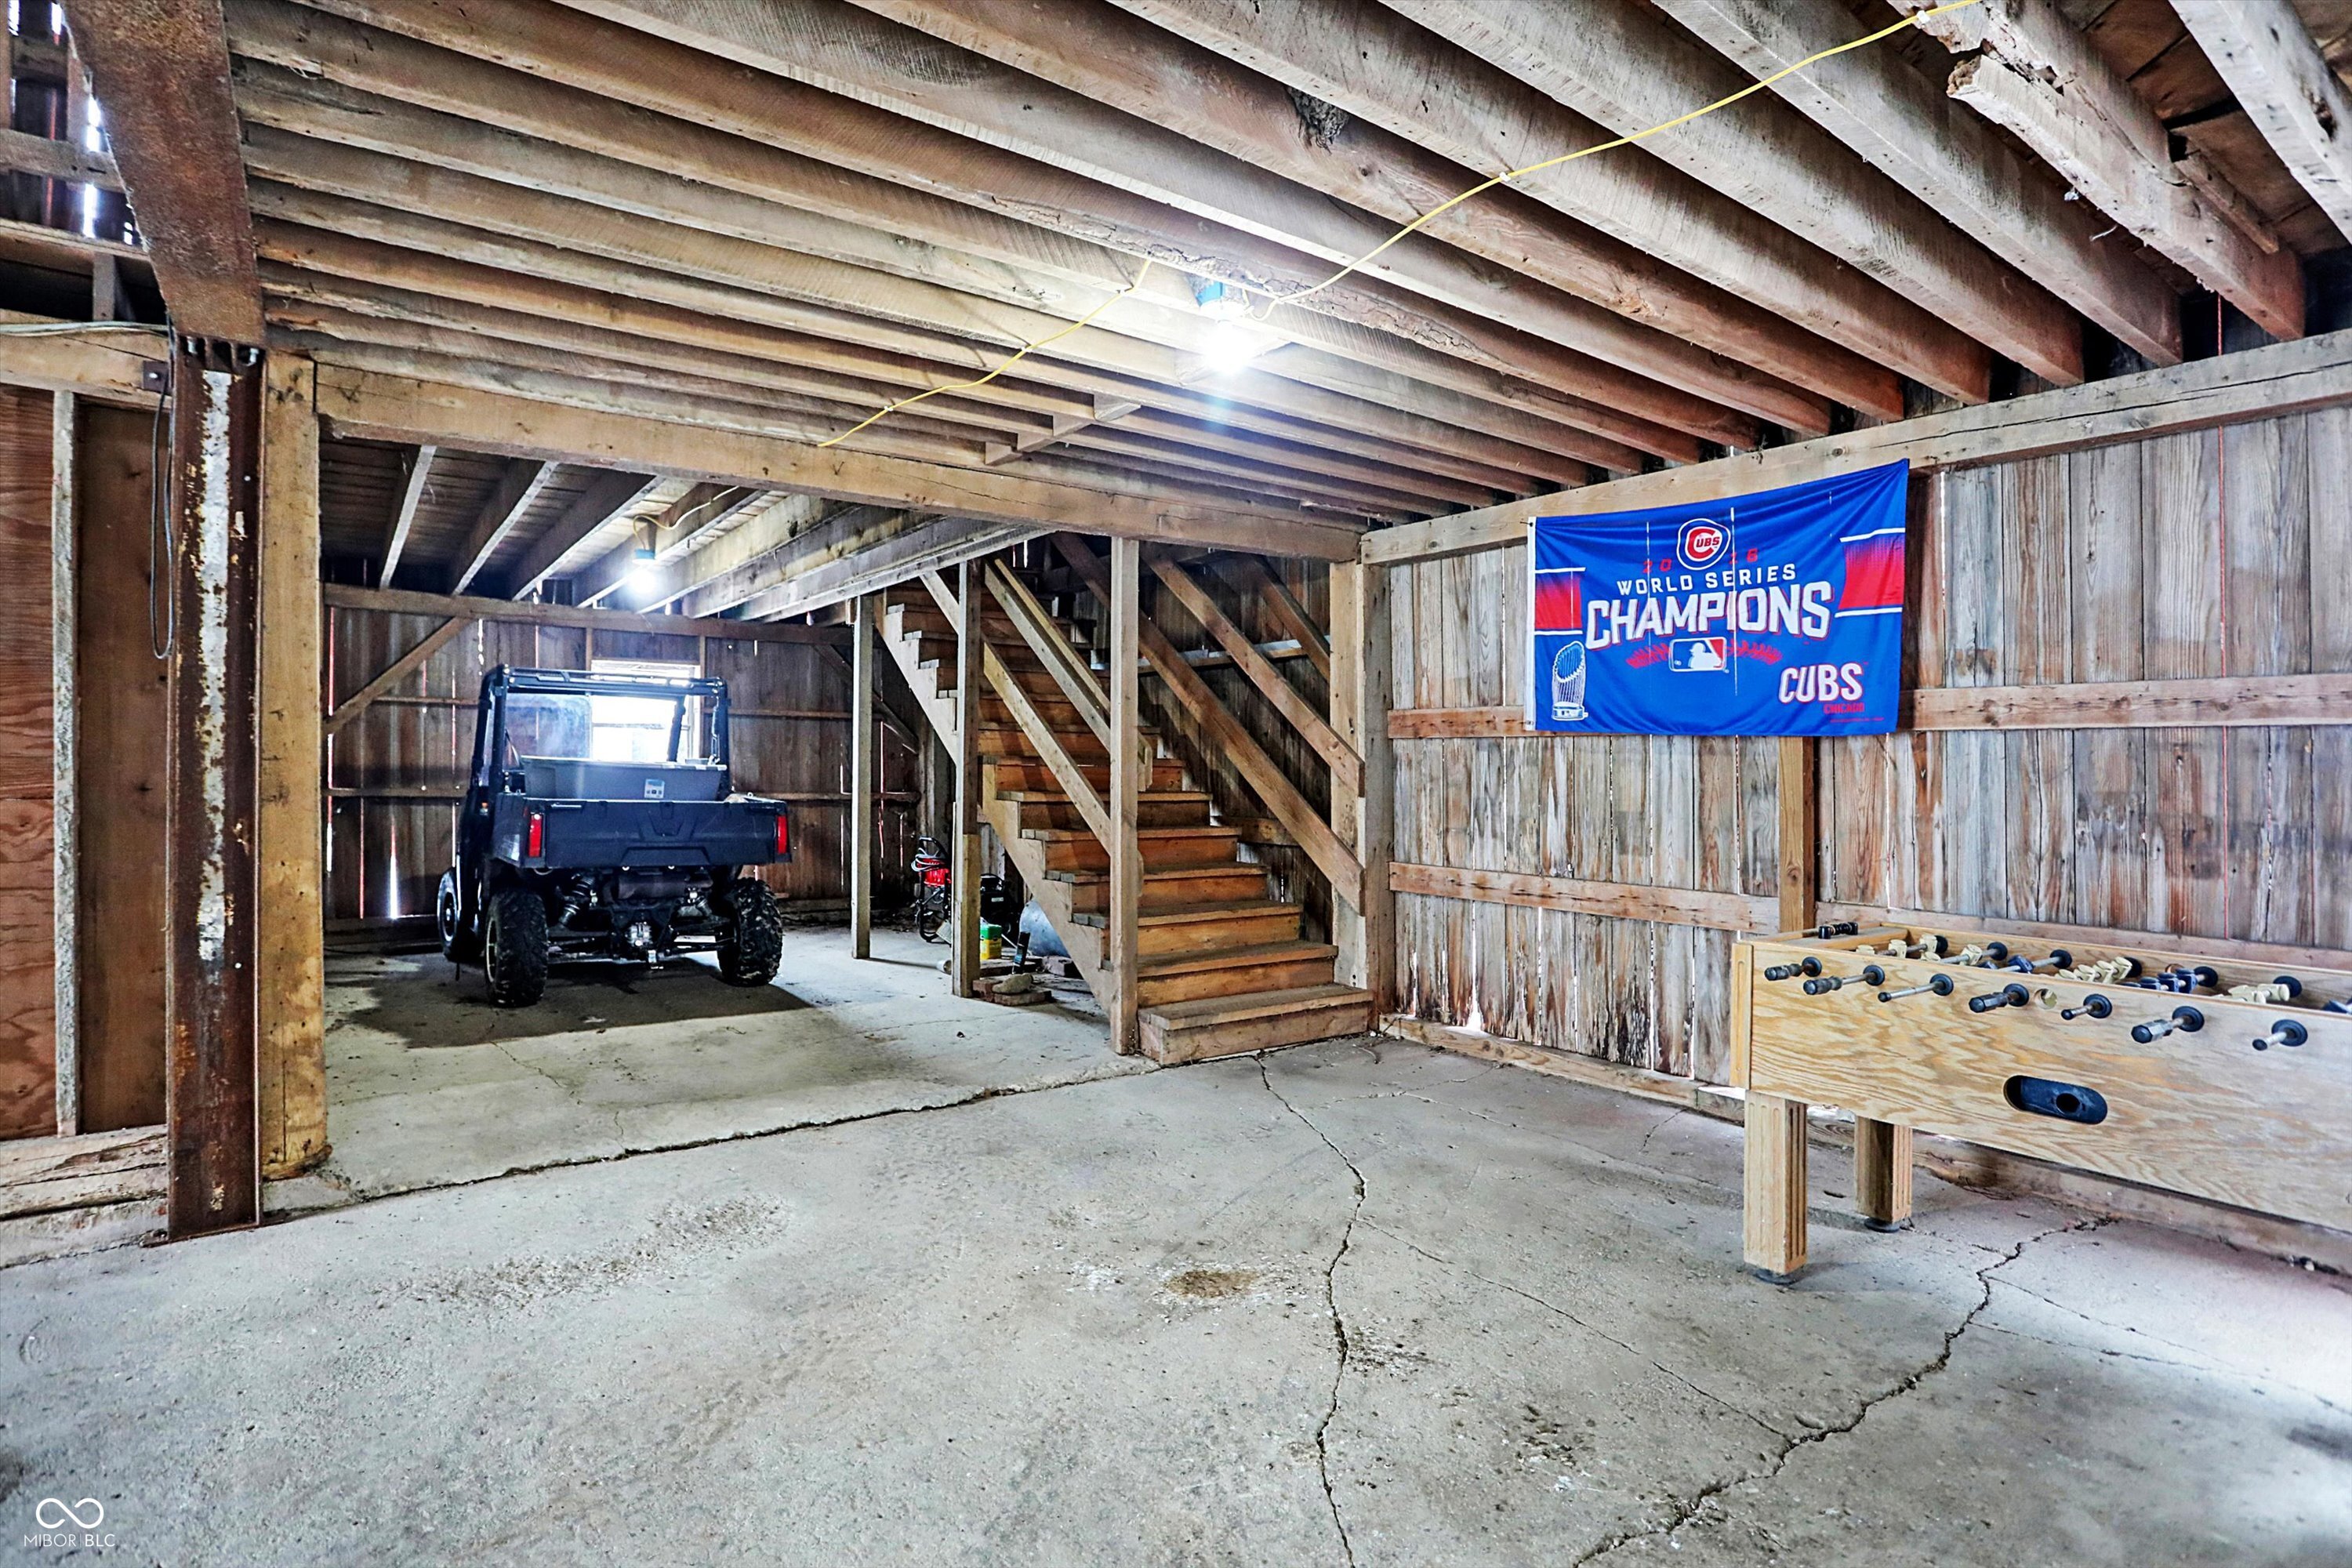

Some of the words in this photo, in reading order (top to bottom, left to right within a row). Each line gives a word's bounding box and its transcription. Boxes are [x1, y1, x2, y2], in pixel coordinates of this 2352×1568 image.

[1687, 526, 1721, 560] CUBS
[1617, 574, 1693, 596] WORLD
[1704, 563, 1796, 589] SERIES
[1584, 580, 1835, 651] CHAMPIONS
[1777, 661, 1864, 704] CUBS
